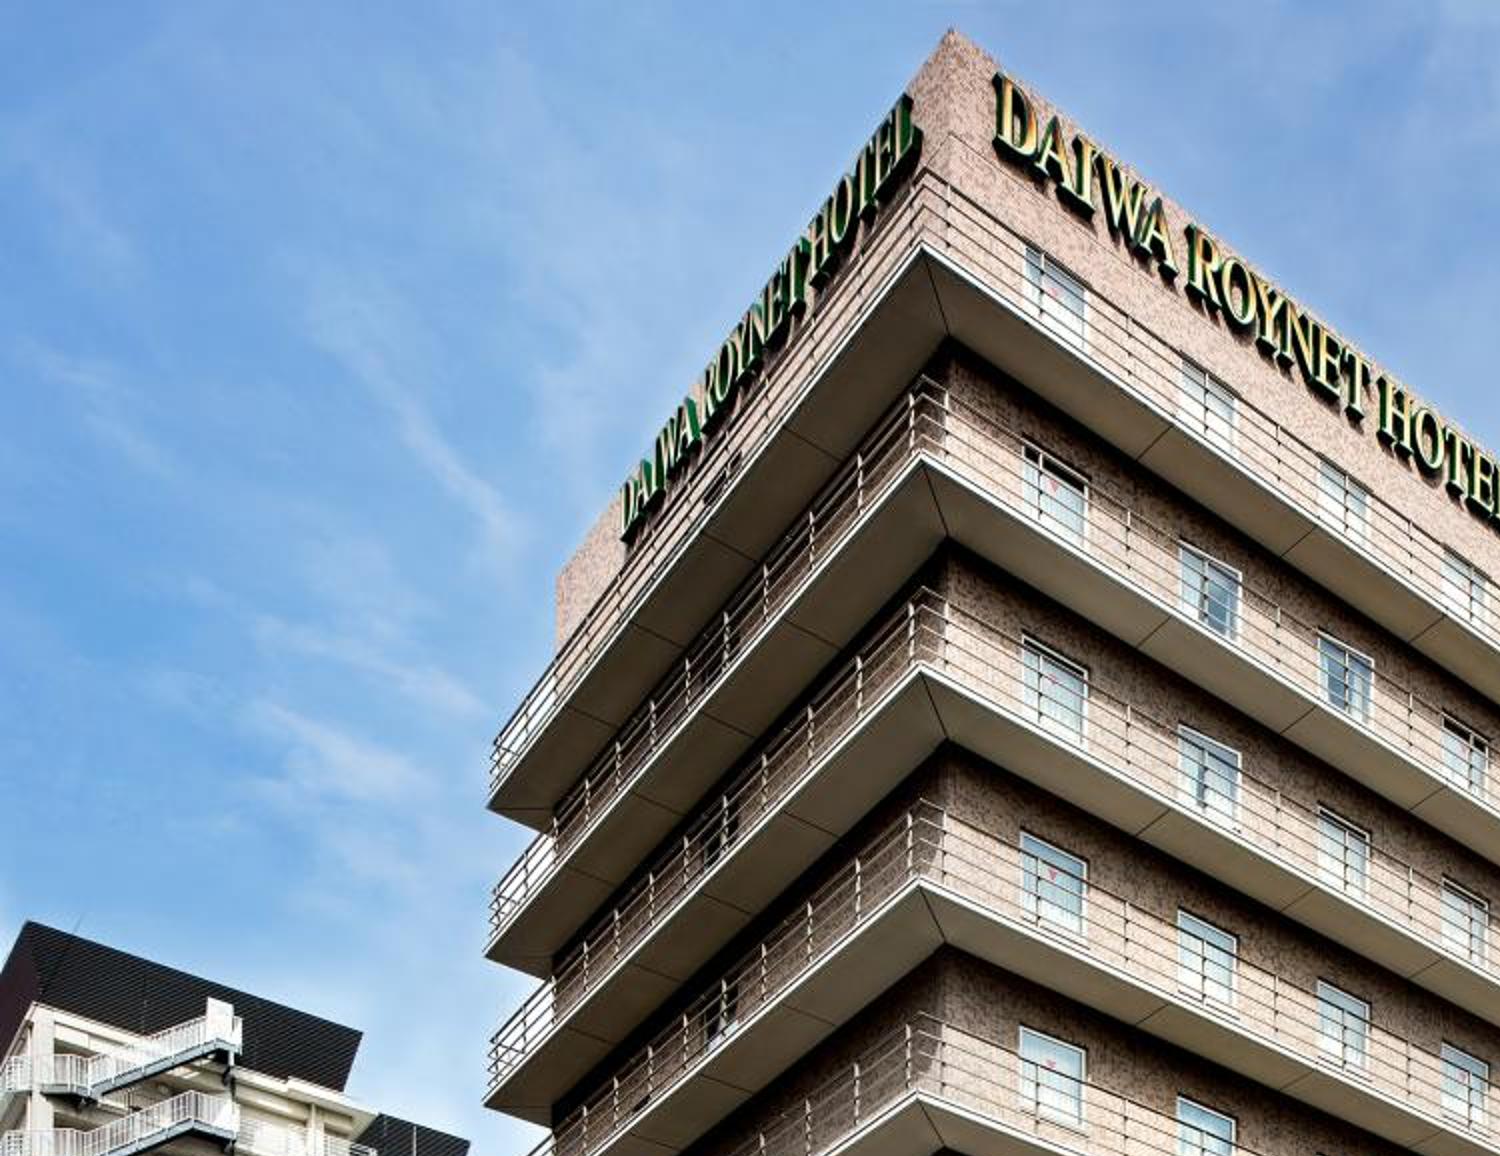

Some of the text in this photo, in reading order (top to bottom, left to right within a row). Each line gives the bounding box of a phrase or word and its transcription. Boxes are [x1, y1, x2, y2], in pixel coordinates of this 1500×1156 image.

[619, 93, 922, 542] DAIWA ROYNET HOTEL
[992, 71, 1179, 279] DAIWA
[1185, 223, 1371, 421] ROYNET
